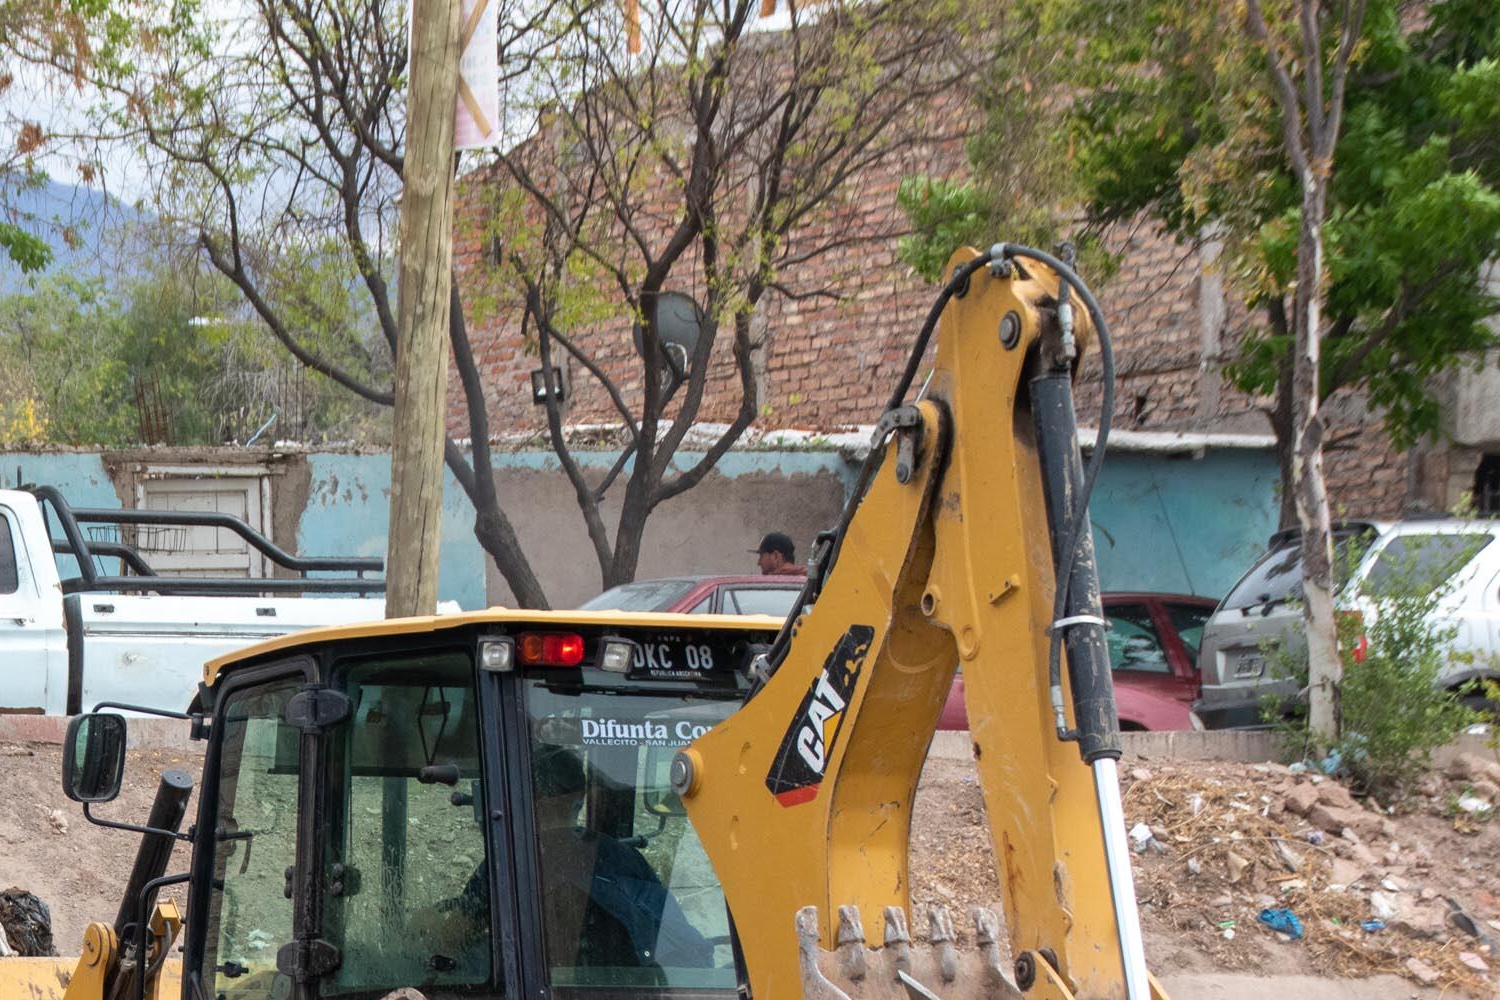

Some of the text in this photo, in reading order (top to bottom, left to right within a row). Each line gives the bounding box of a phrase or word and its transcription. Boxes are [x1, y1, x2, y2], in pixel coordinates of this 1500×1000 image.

[633, 643, 713, 669] DKC 08
[582, 719, 668, 739] Difunta
[797, 668, 845, 773] CAT
